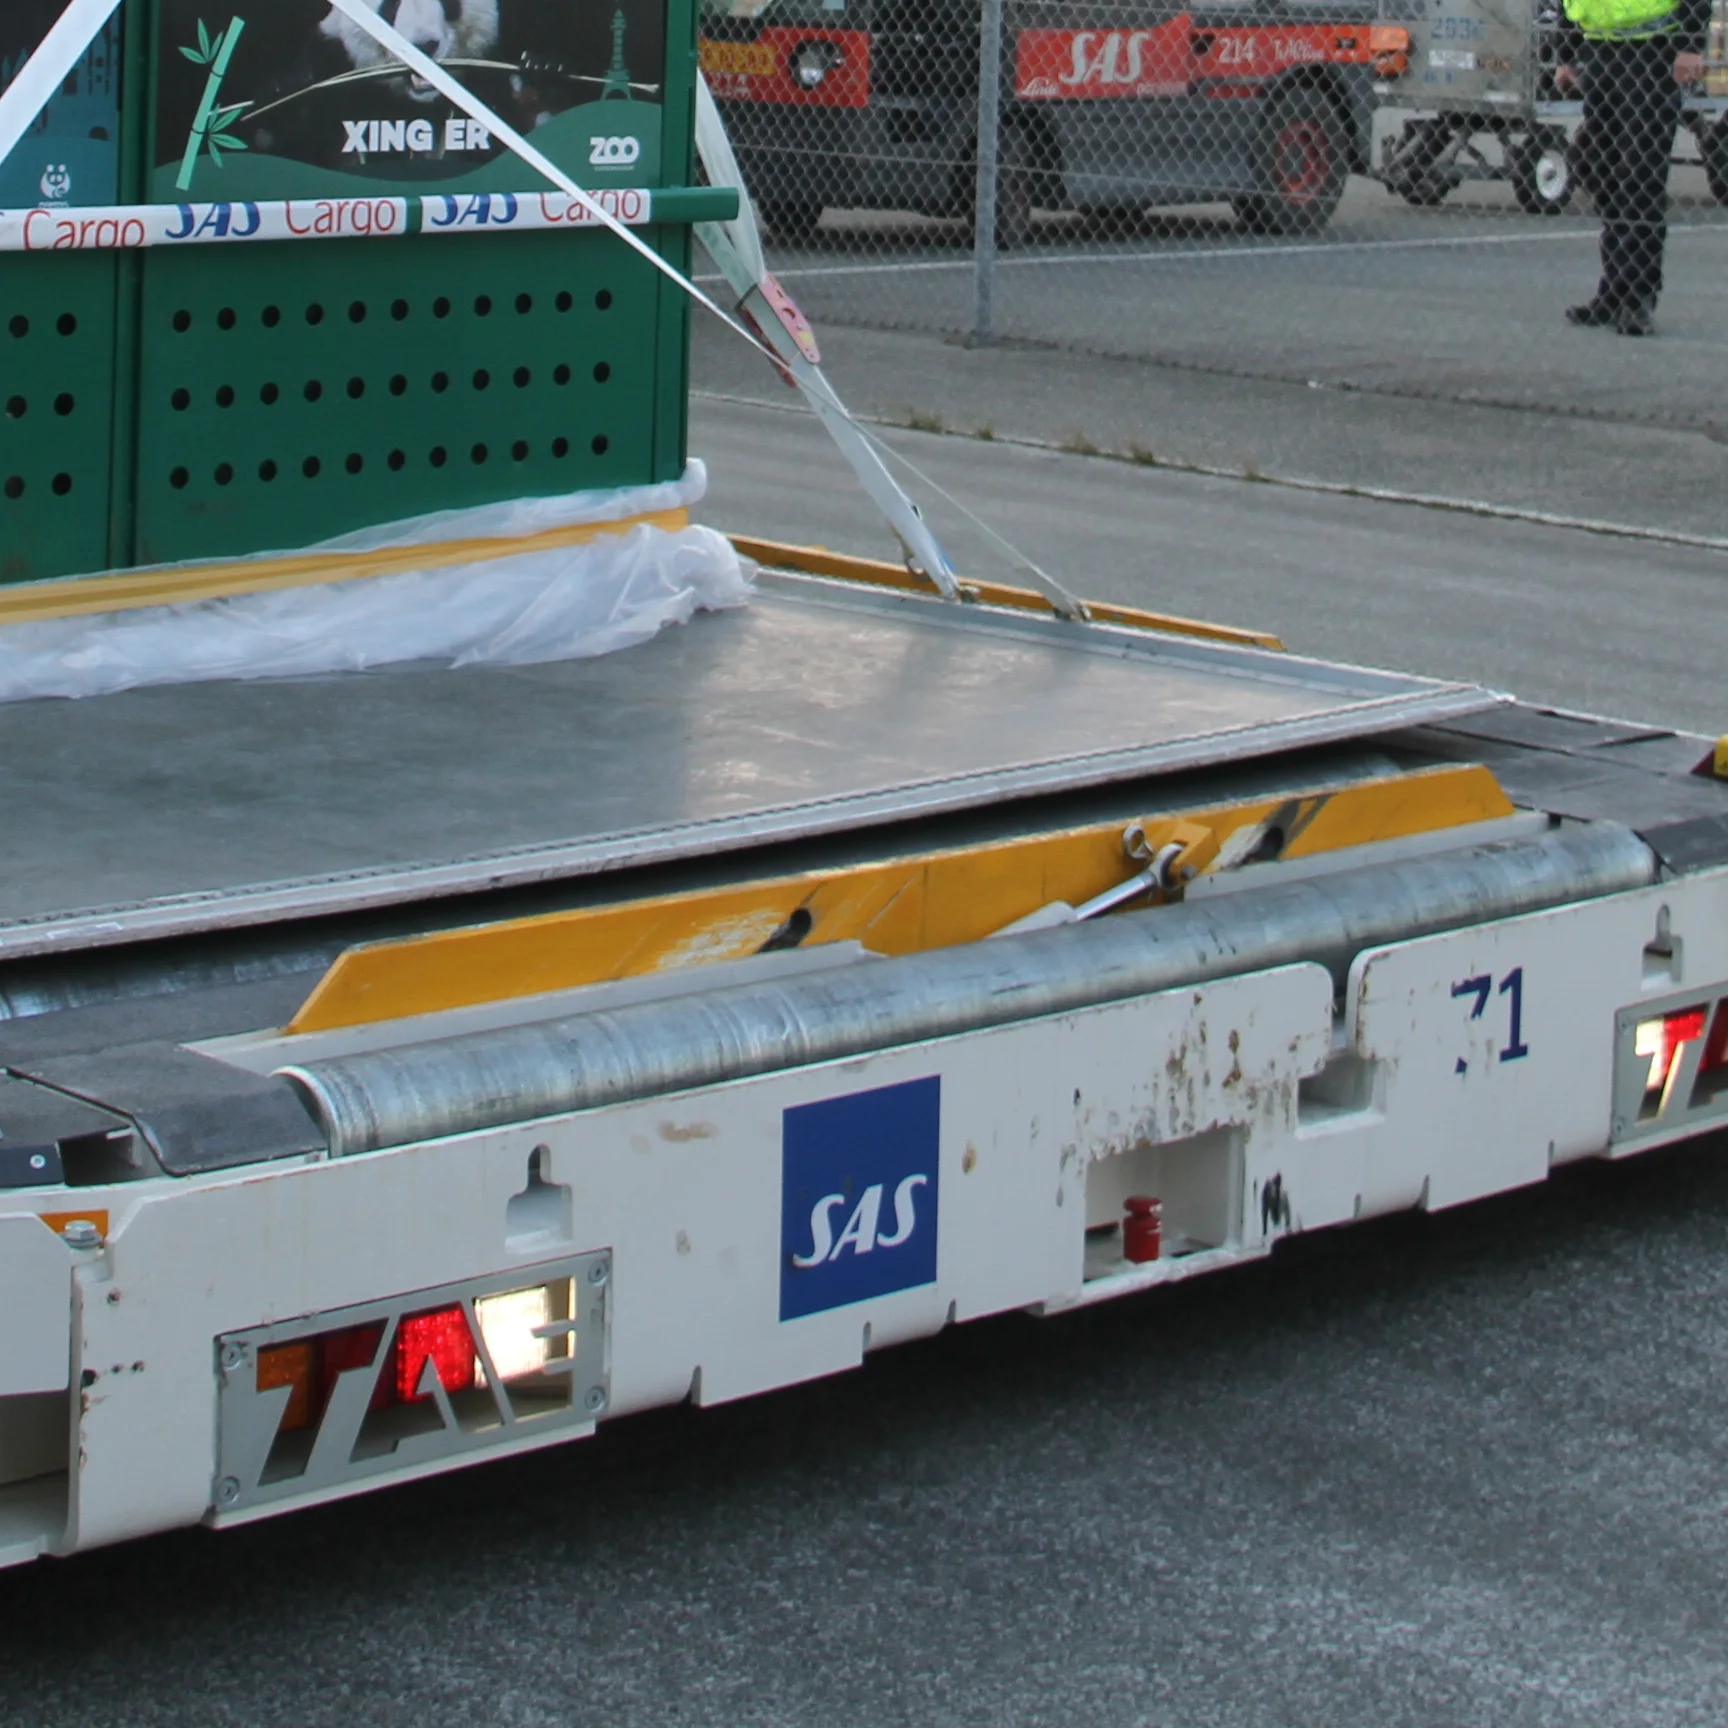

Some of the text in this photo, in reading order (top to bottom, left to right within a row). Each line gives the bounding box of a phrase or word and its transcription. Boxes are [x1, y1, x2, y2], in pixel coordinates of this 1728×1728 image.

[1058, 31, 1150, 85] SAS
[341, 118, 491, 153] XING ER
[23, 209, 145, 250] Cargo
[285, 199, 396, 236] Cargo
[792, 1173, 928, 1268] SAS
